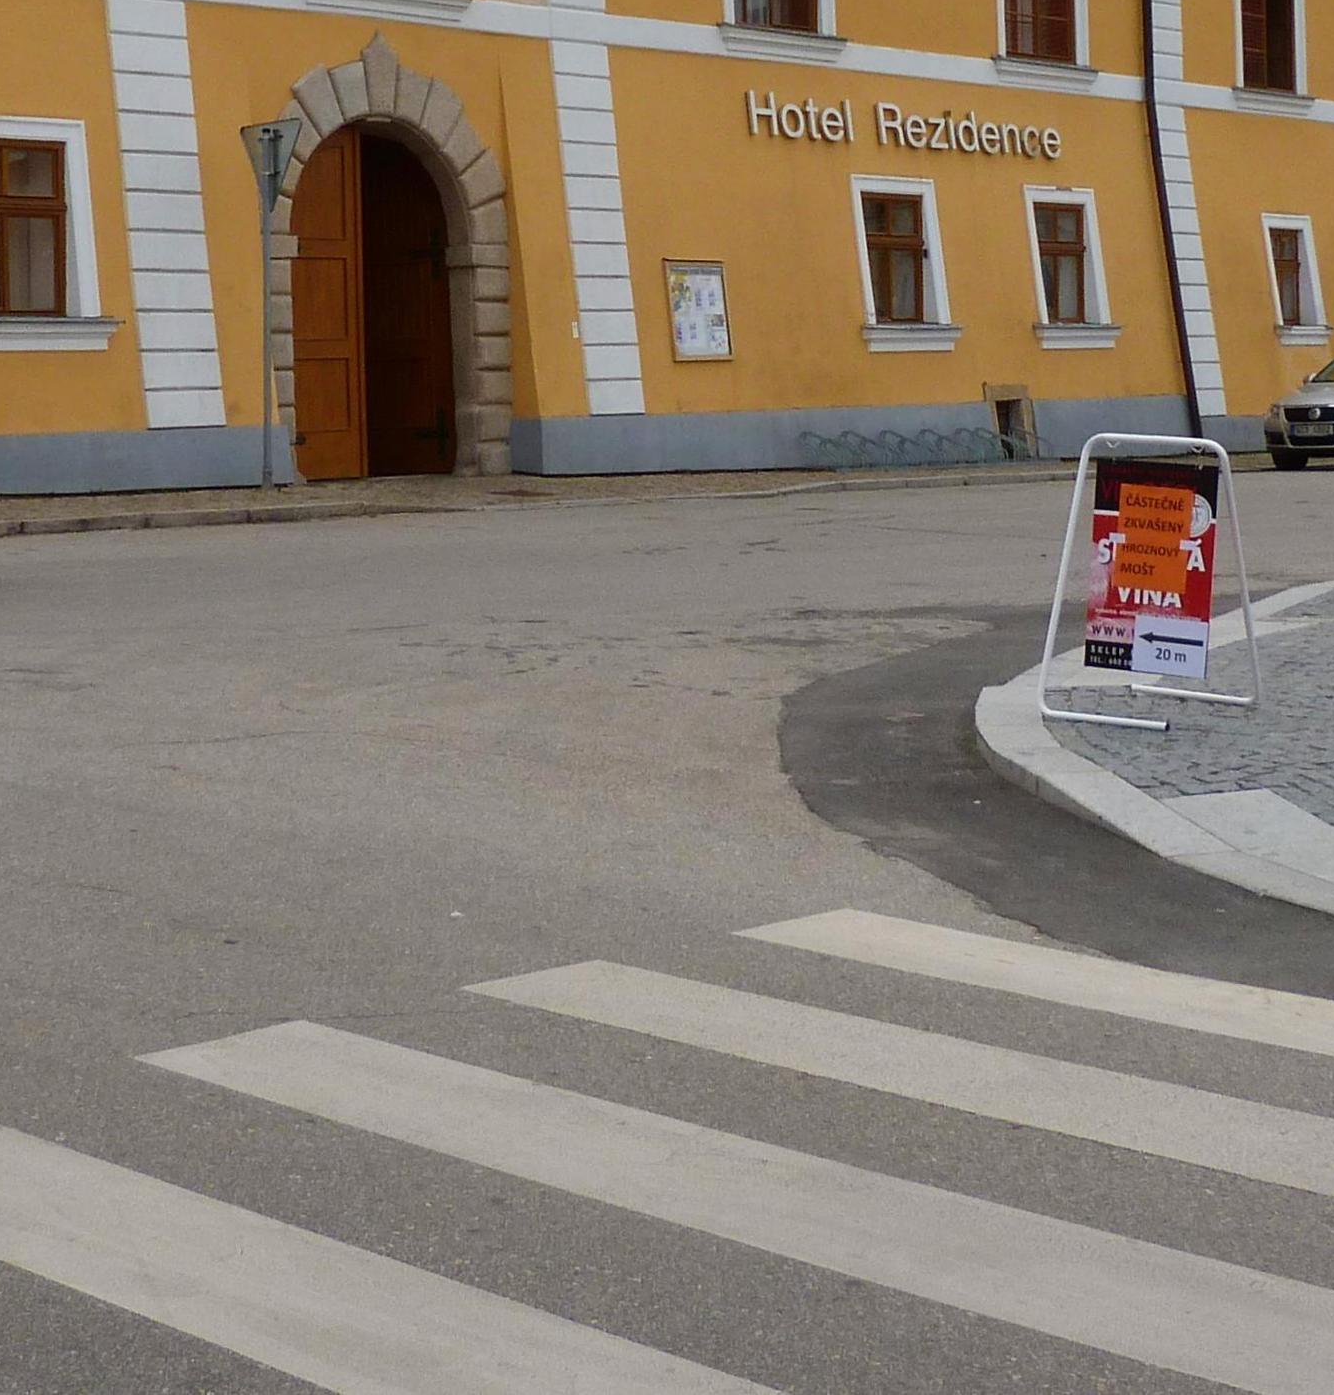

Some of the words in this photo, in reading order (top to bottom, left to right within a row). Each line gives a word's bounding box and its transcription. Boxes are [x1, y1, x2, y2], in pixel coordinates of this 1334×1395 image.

[746, 89, 854, 142] Hotel
[875, 101, 1062, 160] Rezidence
[1120, 562, 1156, 577] MOŠT
[1090, 644, 1125, 657] SKLEP
[1155, 647, 1172, 661] 20
[1174, 653, 1187, 663] m
